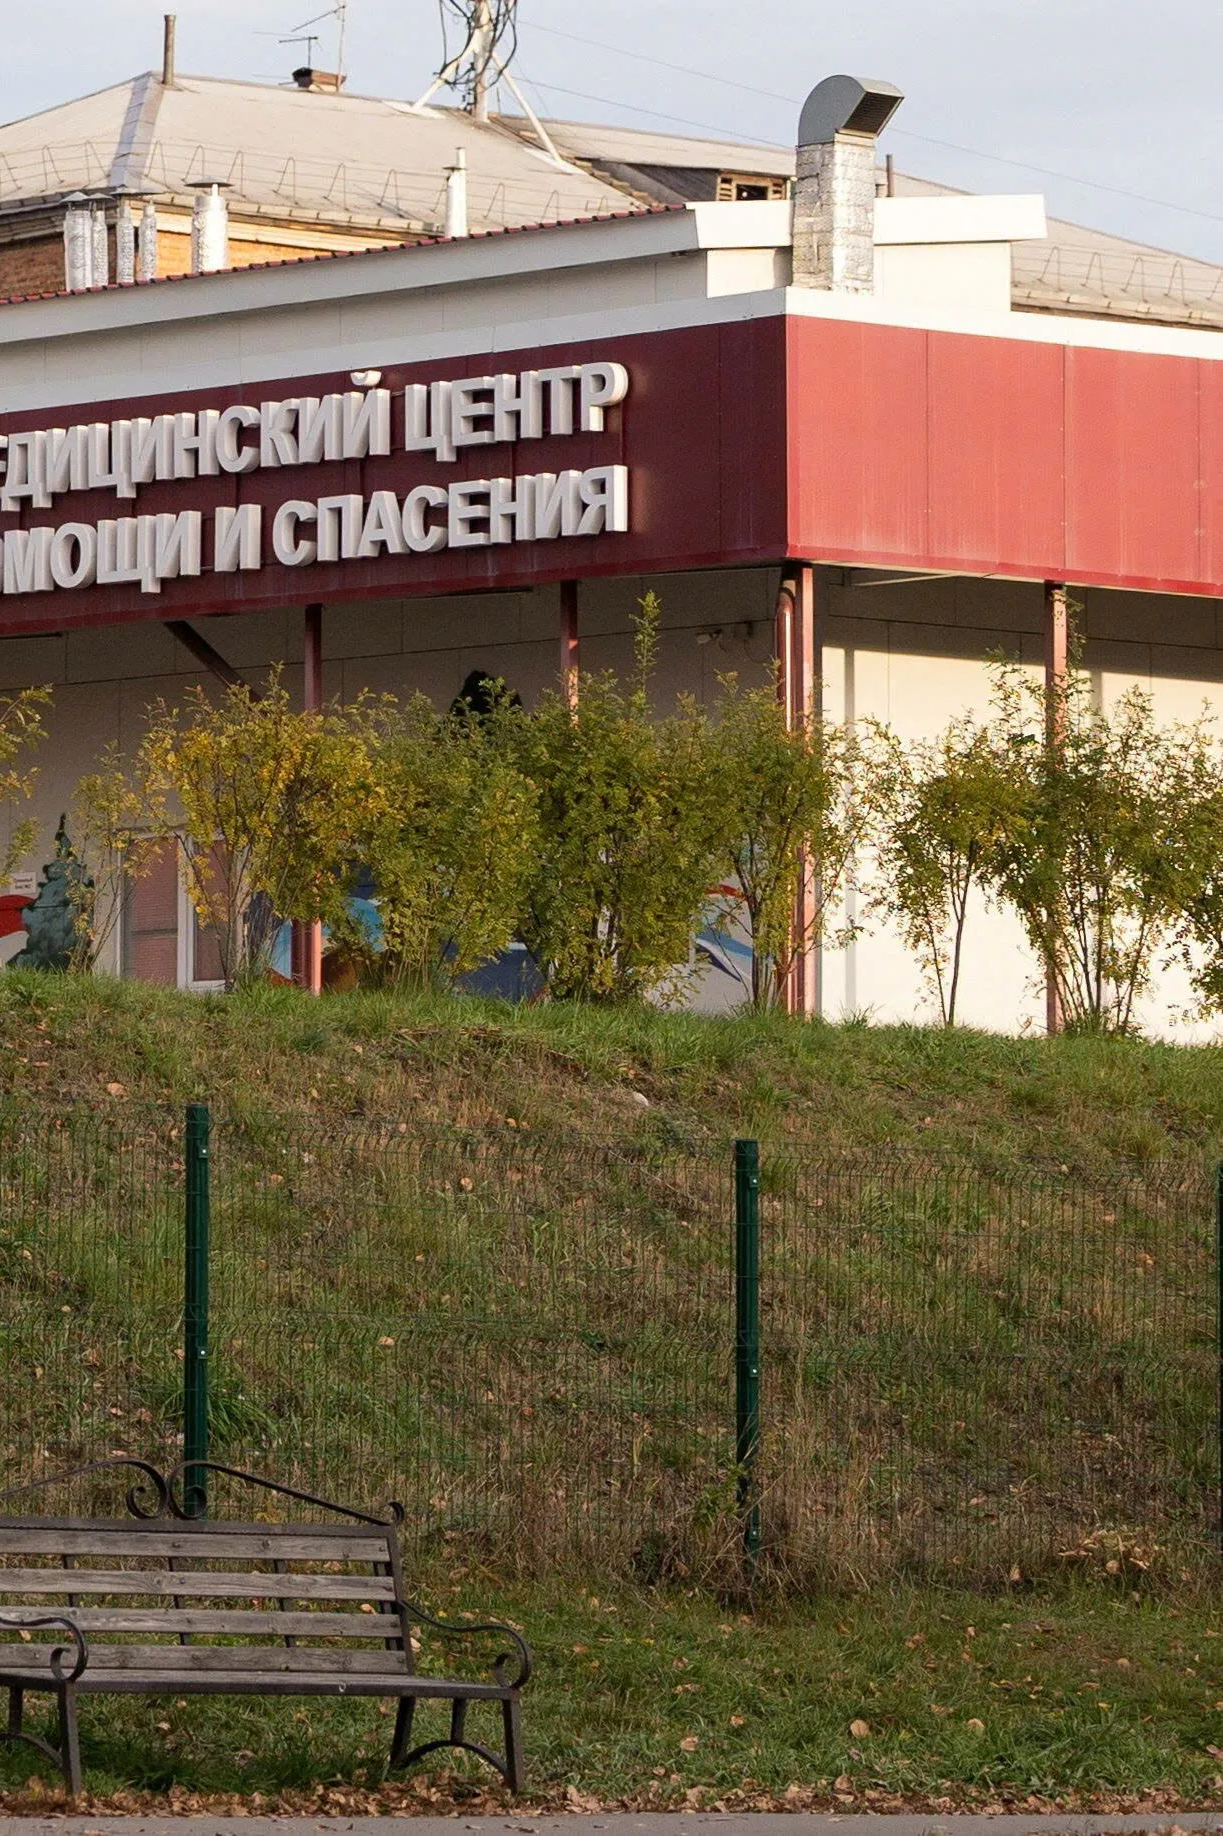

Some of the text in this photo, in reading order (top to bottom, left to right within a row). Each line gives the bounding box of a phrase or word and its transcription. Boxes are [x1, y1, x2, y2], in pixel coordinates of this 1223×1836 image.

[405, 362, 629, 462] ЦЕНТР
[215, 504, 261, 572] И
[273, 465, 628, 567] СПАСЕНИЯ
